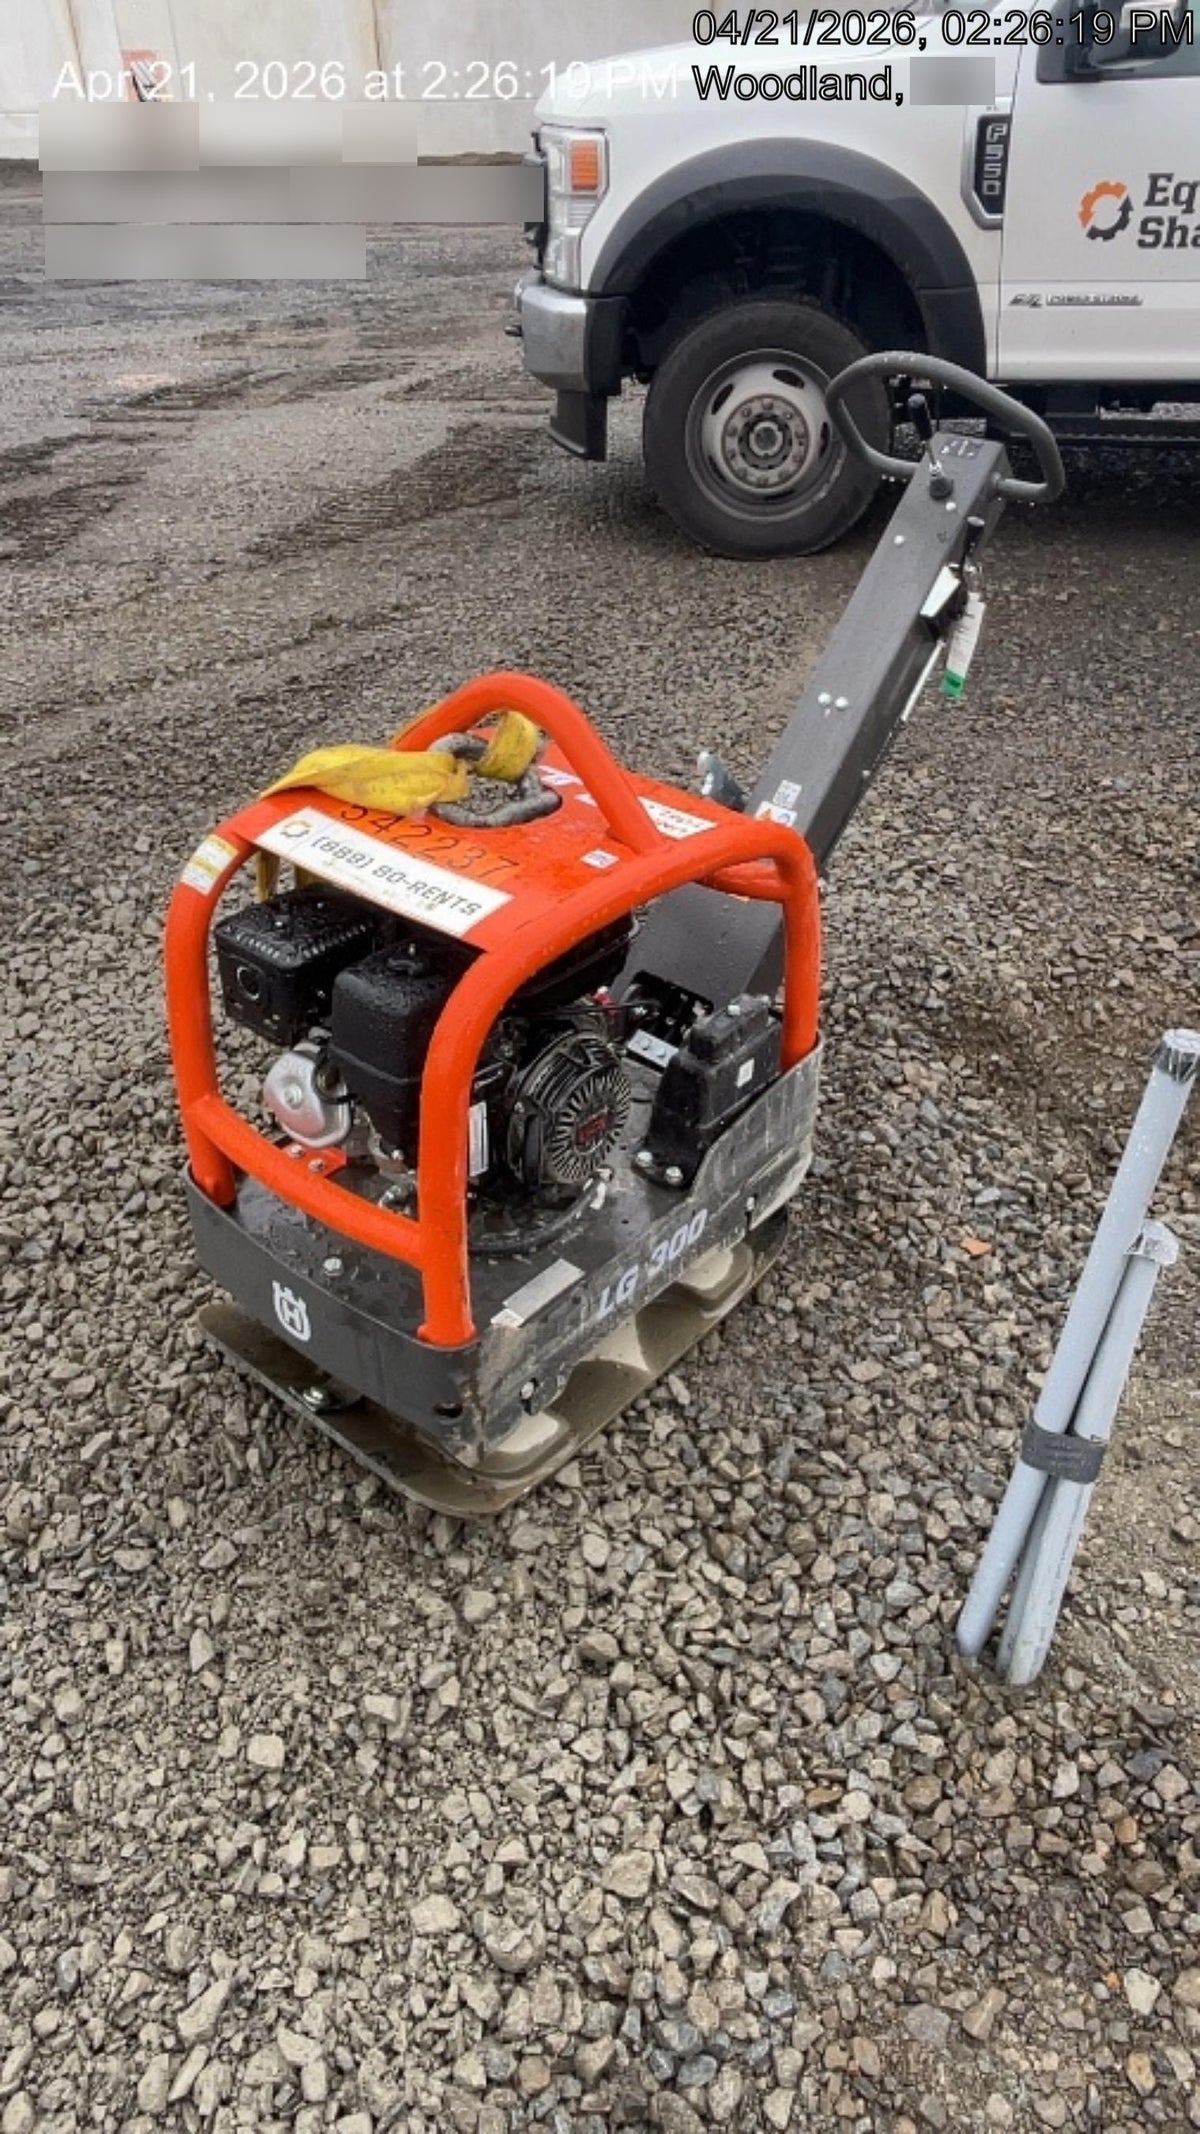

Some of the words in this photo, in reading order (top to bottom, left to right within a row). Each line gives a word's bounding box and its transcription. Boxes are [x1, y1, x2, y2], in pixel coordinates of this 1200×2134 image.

[311, 836, 373, 870] (888)
[371, 864, 483, 917] 80-RENTS
[597, 1263, 639, 1320] LG
[646, 1208, 708, 1277] 300
